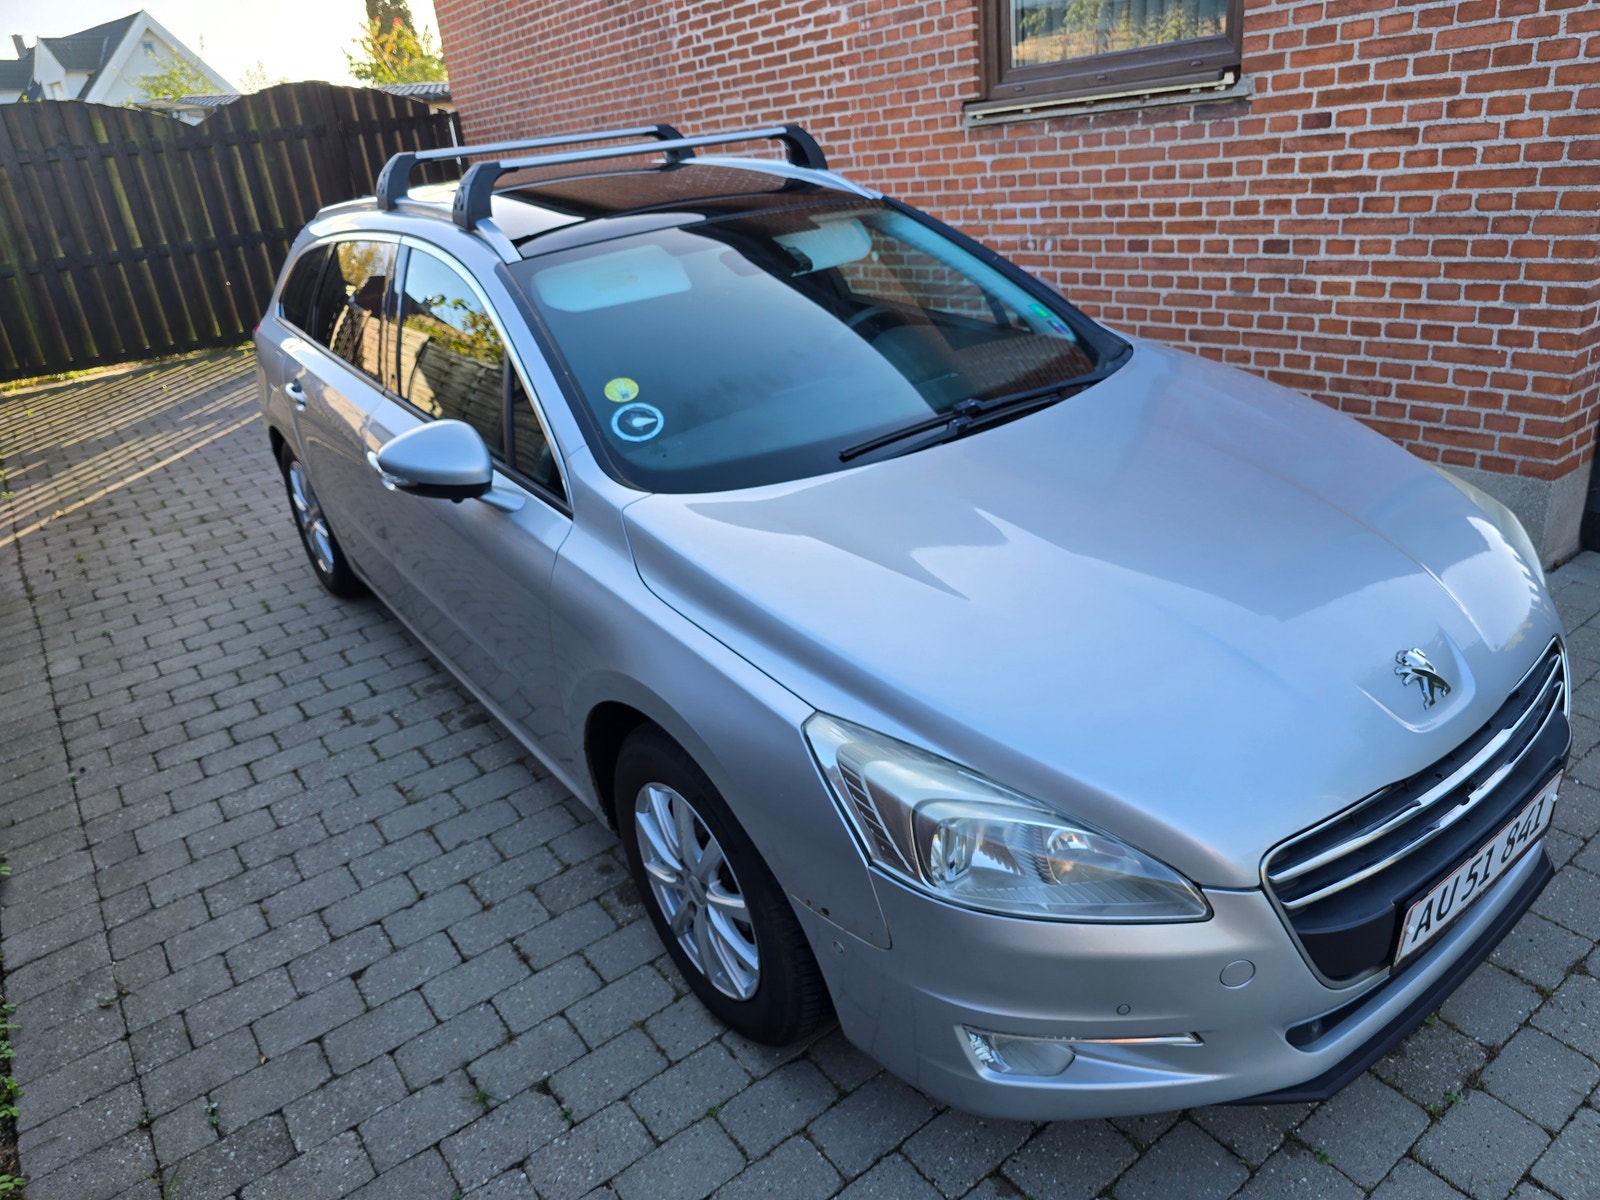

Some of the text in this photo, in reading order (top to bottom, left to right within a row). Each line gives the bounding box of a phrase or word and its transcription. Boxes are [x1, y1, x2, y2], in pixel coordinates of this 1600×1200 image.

[1411, 796, 1546, 943] AU 51 841
